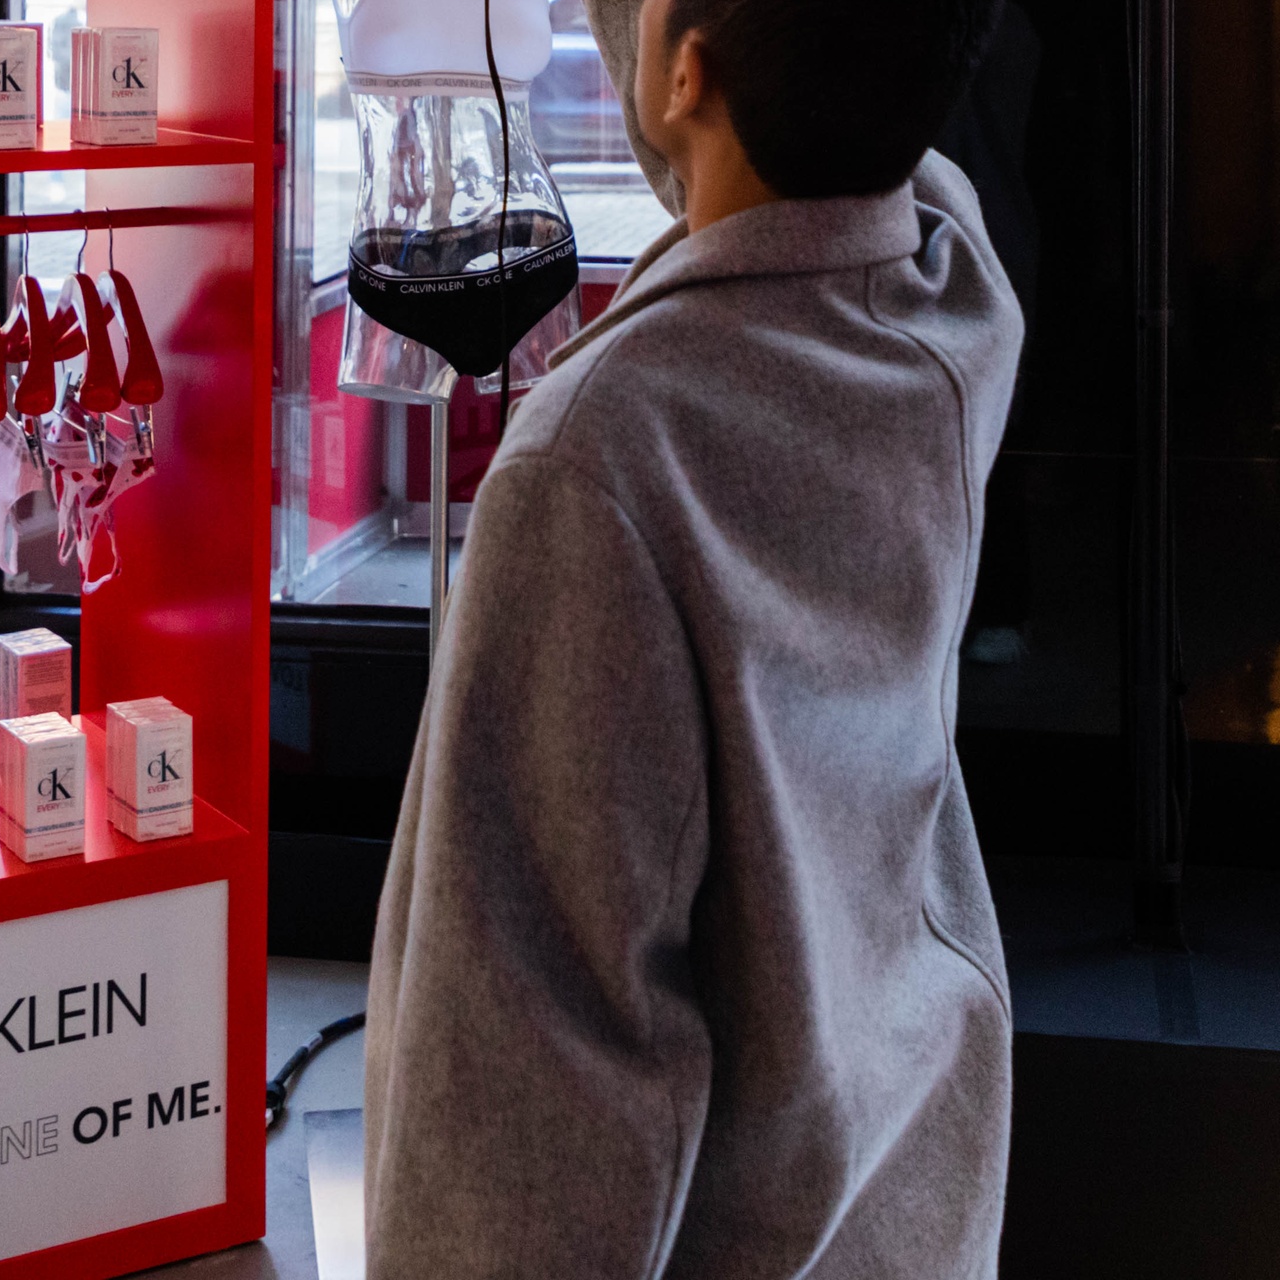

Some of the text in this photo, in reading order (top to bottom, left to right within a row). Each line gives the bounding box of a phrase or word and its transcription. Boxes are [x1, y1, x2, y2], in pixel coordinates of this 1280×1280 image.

[434, 77, 469, 88] CALVIN
[399, 282, 437, 295] CALVIN
[437, 279, 465, 293] KLEIN
[523, 252, 555, 274] CALVIN
[71, 1096, 134, 1146] OF
[146, 1079, 223, 1132] ME.
